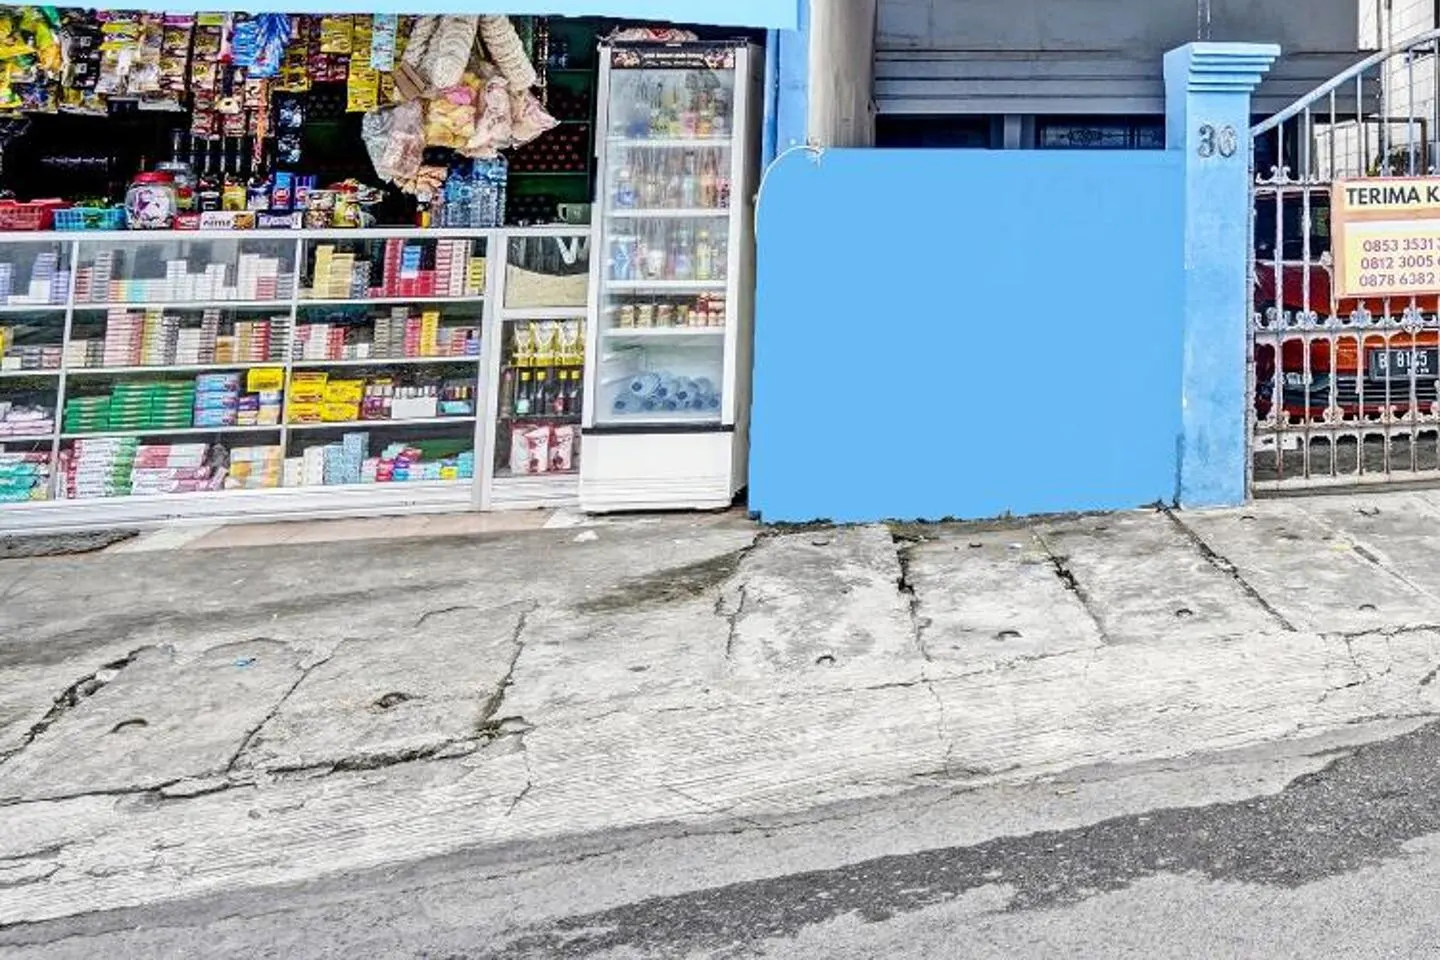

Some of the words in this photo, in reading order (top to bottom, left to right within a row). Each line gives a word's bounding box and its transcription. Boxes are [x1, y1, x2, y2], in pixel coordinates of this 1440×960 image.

[1345, 186, 1421, 206] TERIMA
[1362, 239, 1399, 252] 0853
[1402, 238, 1433, 251] 3531
[1360, 257, 1394, 270] 0812
[1398, 255, 1434, 268] 3005
[1359, 274, 1395, 287] 0878
[1399, 272, 1435, 285] 6382
